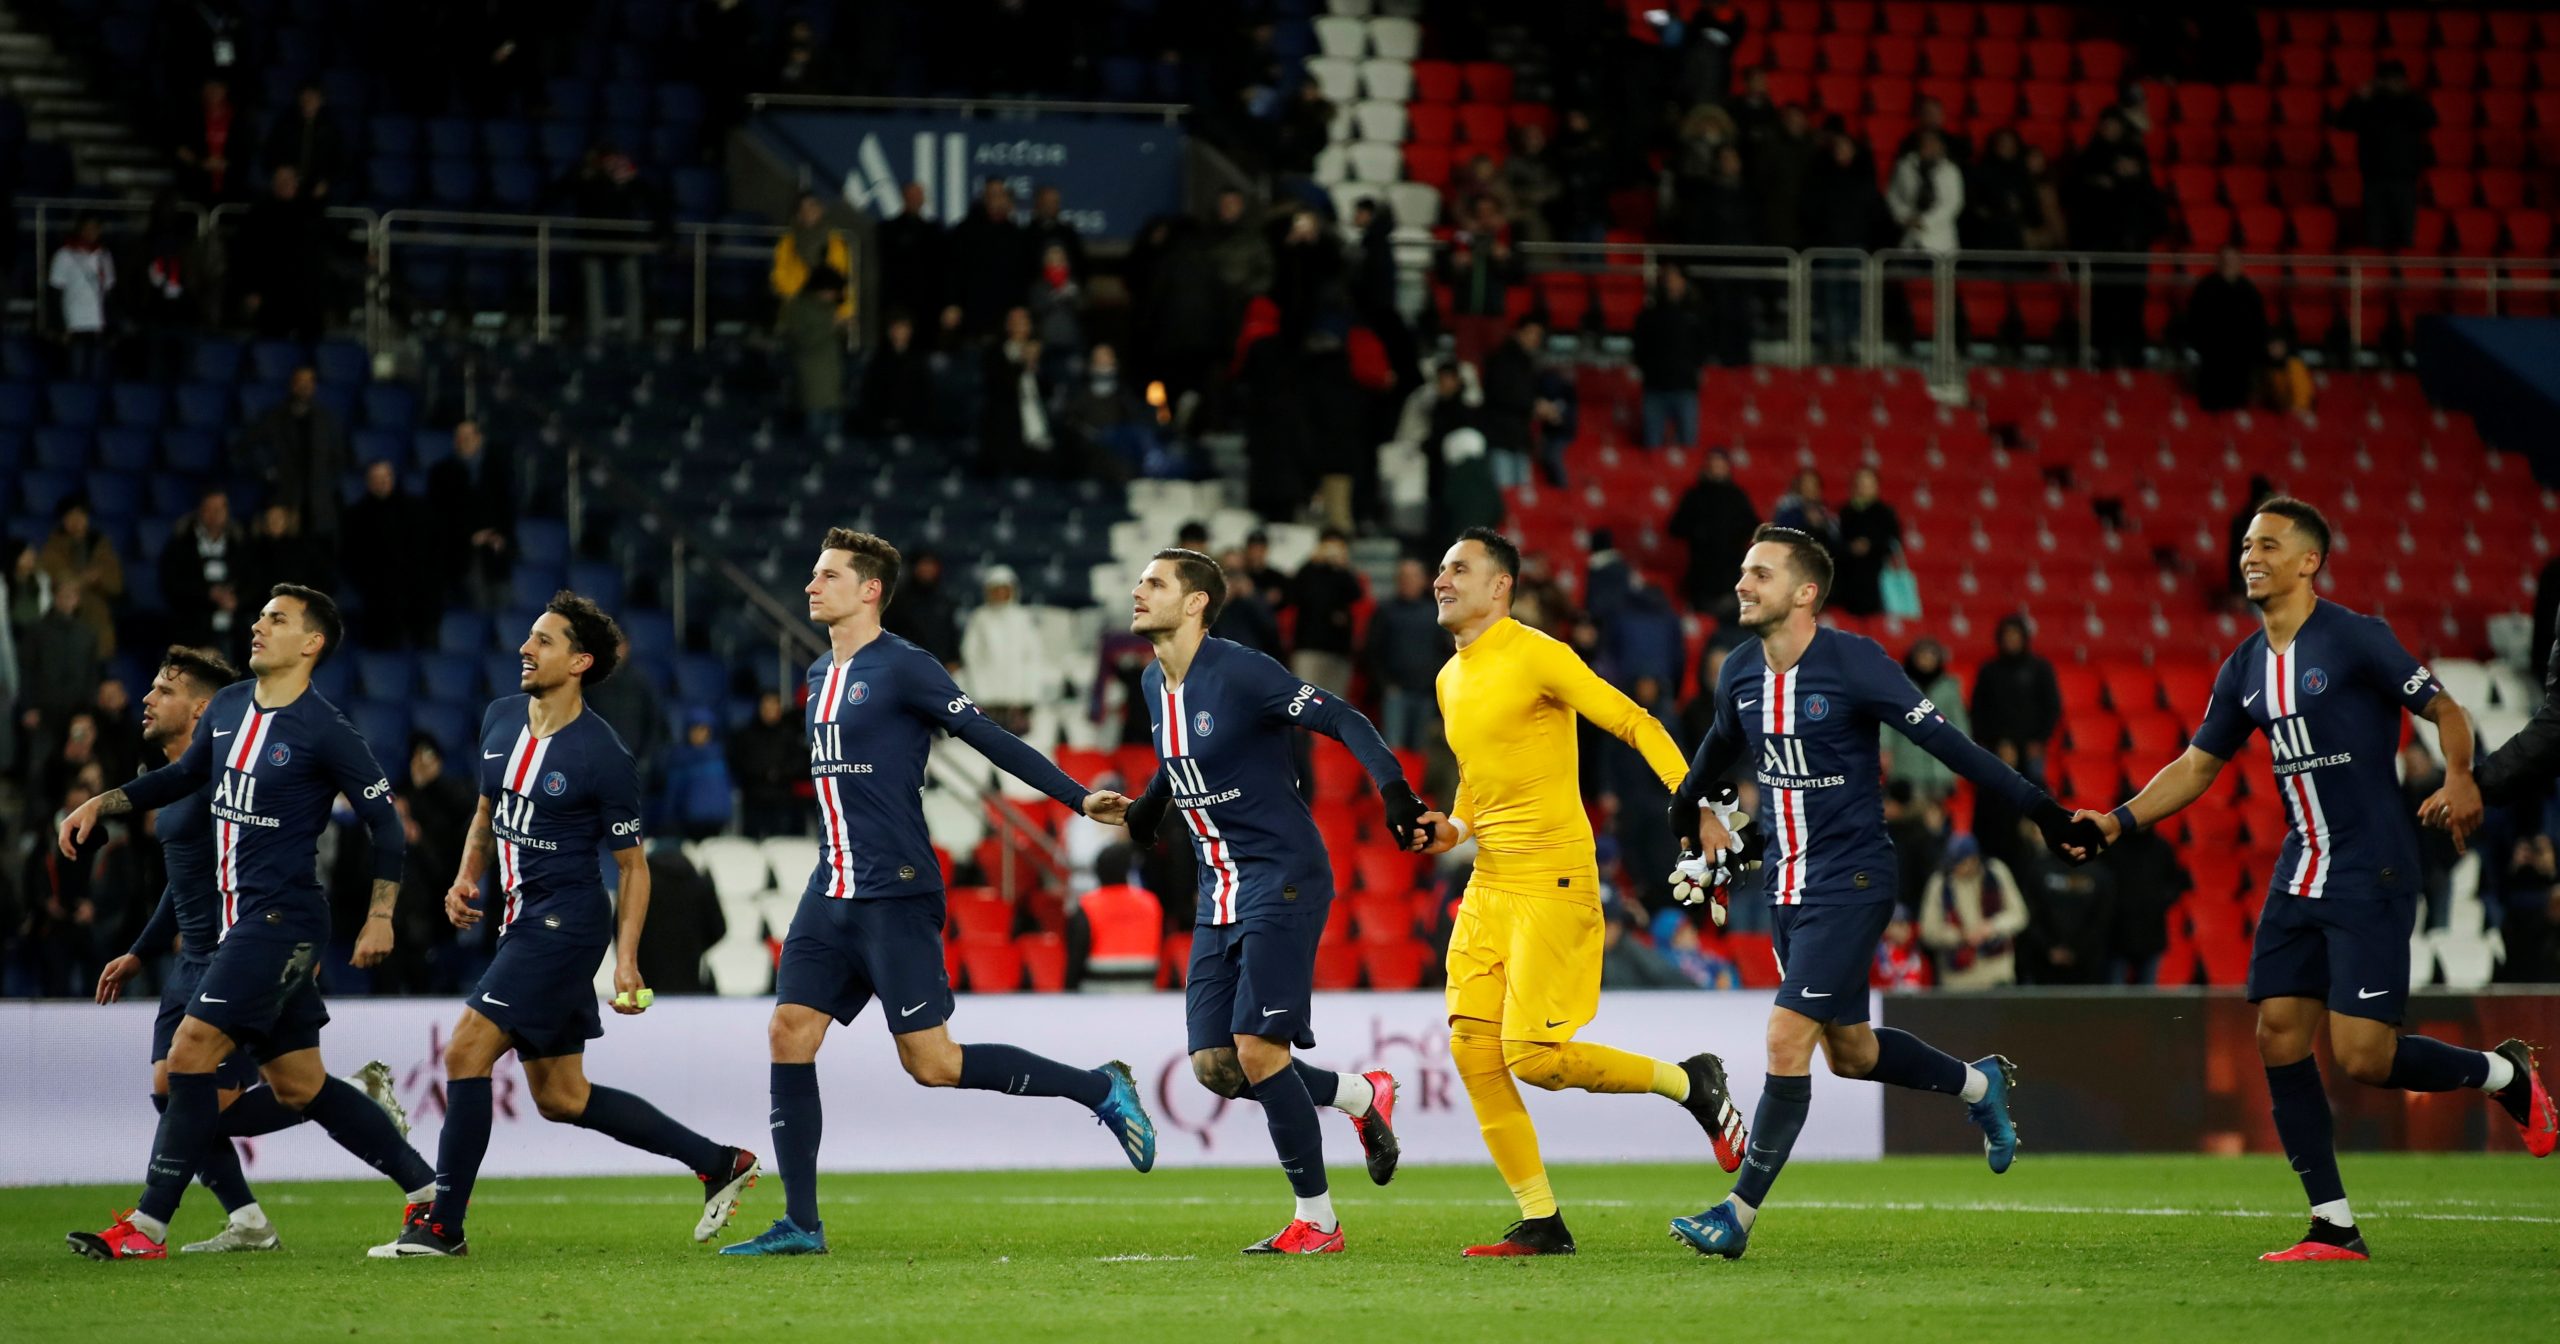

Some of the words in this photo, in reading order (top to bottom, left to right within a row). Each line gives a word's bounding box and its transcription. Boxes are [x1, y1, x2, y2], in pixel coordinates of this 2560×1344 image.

[2402, 665, 2431, 695] QNB
[1287, 684, 1316, 717] QNB
[1904, 698, 1936, 725] QNB
[815, 764, 828, 775] LIVE
[827, 763, 873, 774] LIMITLESS
[2281, 762, 2298, 774] LIVE
[2297, 752, 2352, 771] LIMITLESS
[1771, 776, 1791, 788] LIVE
[1790, 775, 1845, 788] LIMITLESS
[1179, 798, 1195, 808] LIVE
[1194, 788, 1242, 807] LIMITLESS
[217, 806, 233, 820] LIVE
[232, 811, 280, 828] LIMITLESS
[495, 825, 511, 839] LIVE
[510, 832, 558, 851] LIMITLESS
